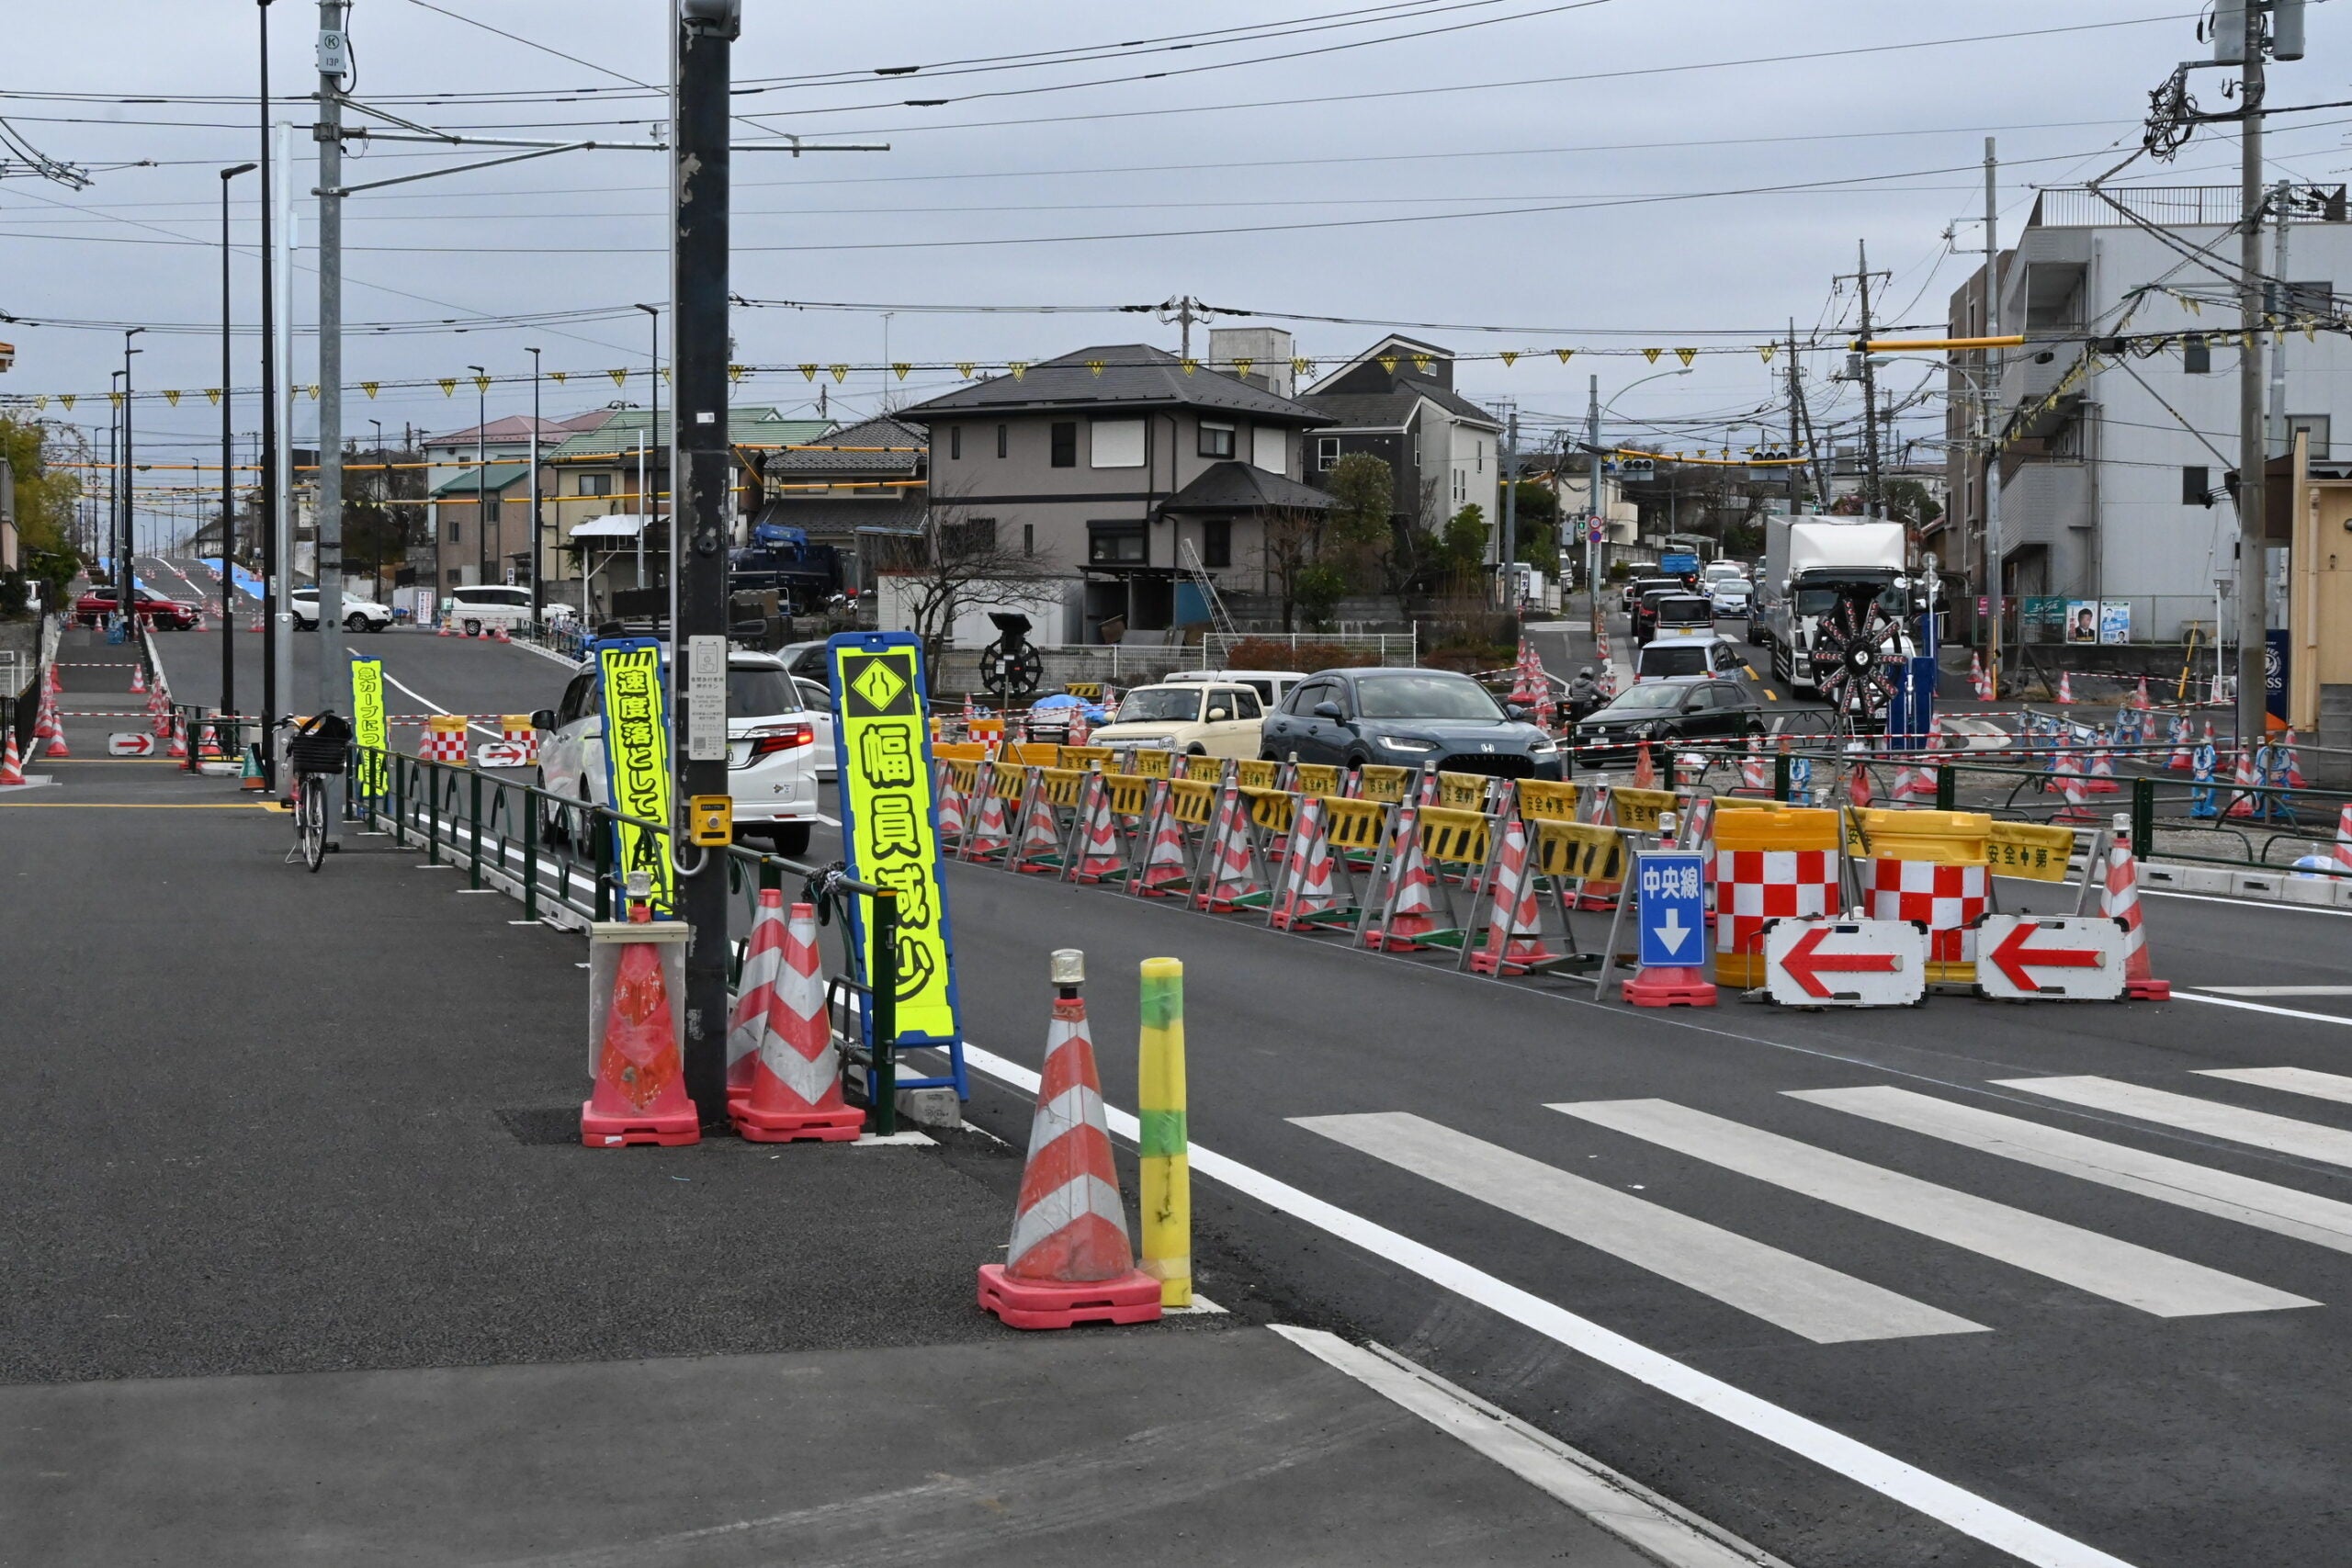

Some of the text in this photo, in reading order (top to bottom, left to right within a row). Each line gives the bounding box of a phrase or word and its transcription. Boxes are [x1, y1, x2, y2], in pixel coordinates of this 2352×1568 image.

[358, 667, 380, 749] 急カーブにつ
[2266, 677, 2282, 689] SS
[860, 723, 934, 1002] 幅員減少
[1643, 866, 1699, 899] 中央線
